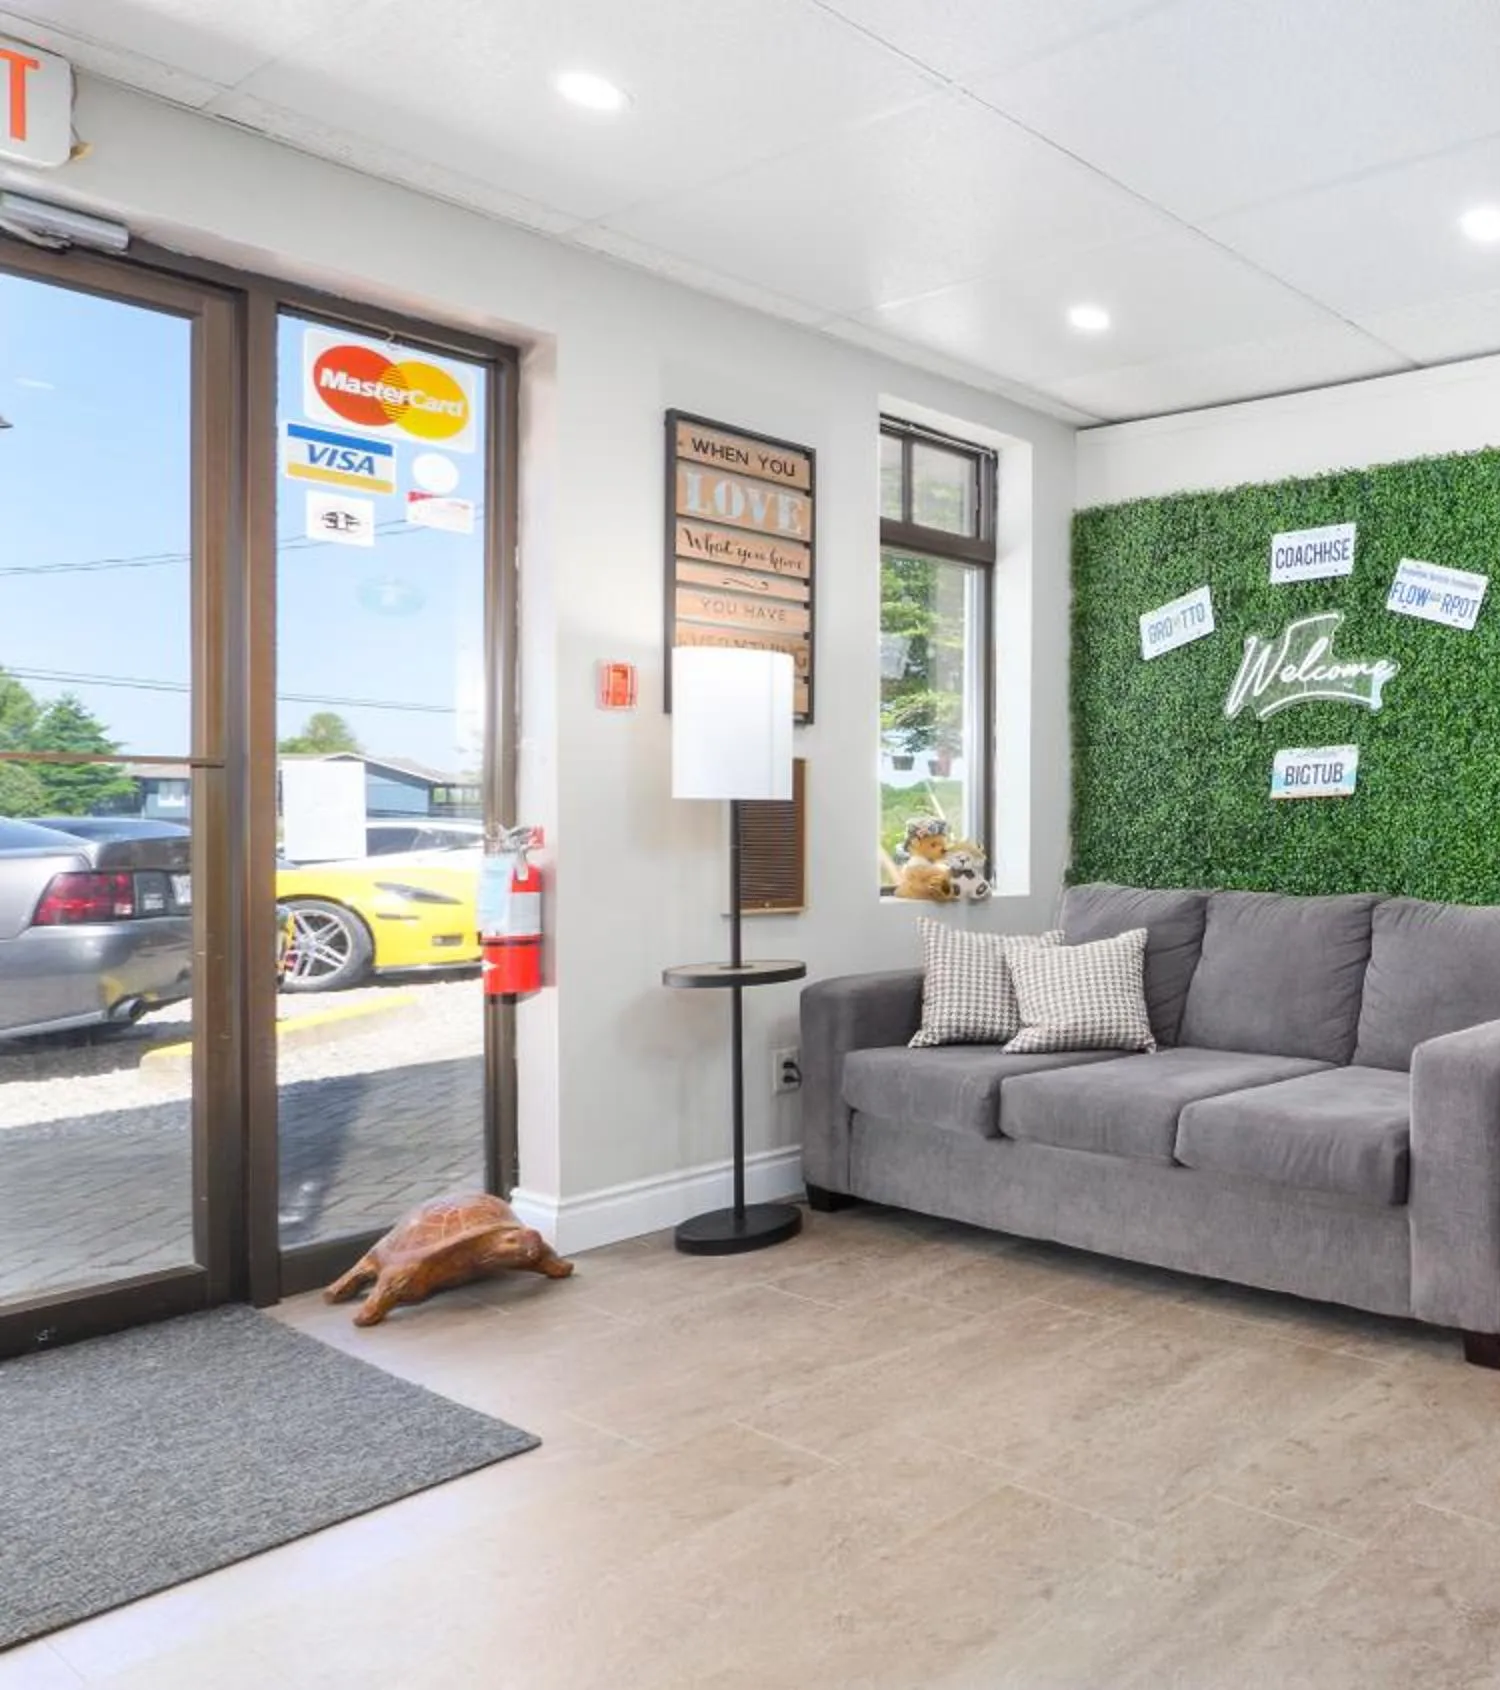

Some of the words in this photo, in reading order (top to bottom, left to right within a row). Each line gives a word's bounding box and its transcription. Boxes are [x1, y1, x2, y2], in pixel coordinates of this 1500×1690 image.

[319, 367, 463, 417] MasterCard
[306, 443, 375, 475] VISA
[691, 437, 749, 466] WHEN
[757, 455, 796, 477] YOU
[684, 472, 803, 534] LOVE
[1275, 538, 1351, 569] COACHHSE
[701, 597, 737, 613] YOU
[744, 607, 786, 622] HAVE
[1226, 613, 1399, 715] Welcome
[1284, 762, 1344, 786] BIGTUB
